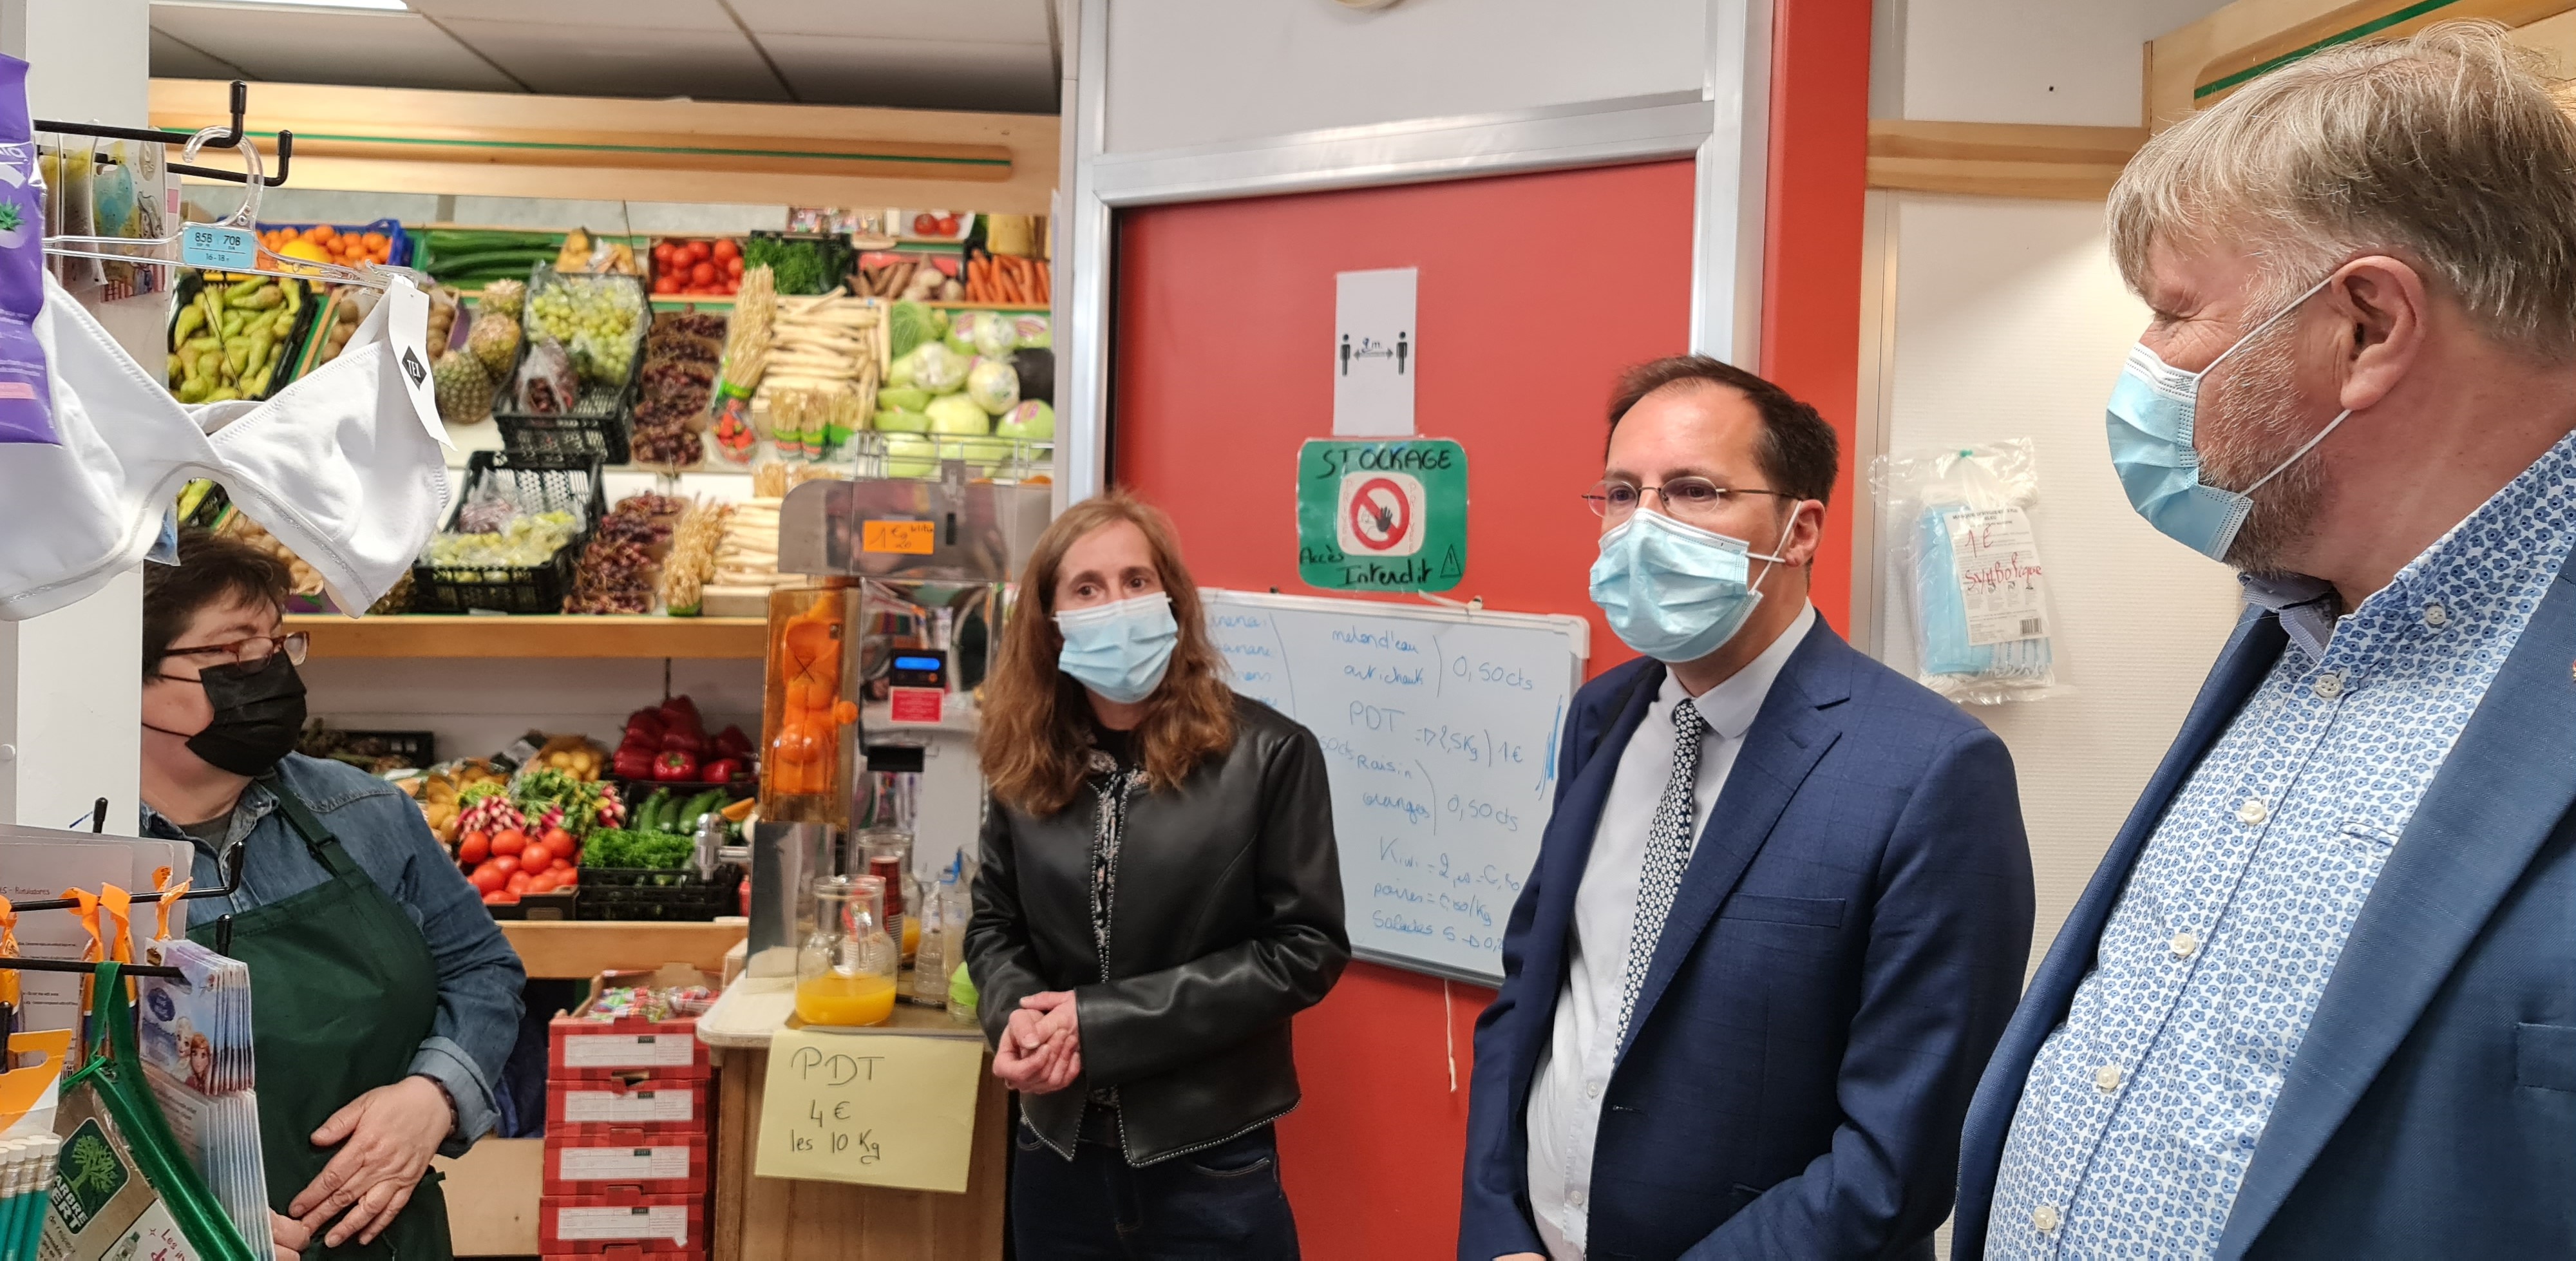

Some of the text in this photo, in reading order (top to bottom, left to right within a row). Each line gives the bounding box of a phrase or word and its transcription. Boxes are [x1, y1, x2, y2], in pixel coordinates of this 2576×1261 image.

[195, 232, 241, 245] 85B 70B
[406, 359, 421, 378] TEX
[1317, 449, 1452, 478] STOCKAGE
[1300, 545, 1344, 564] Accès
[1965, 529, 1977, 558] 1
[1337, 558, 1432, 587] Interdit
[1350, 701, 1405, 732] PDT
[791, 1046, 886, 1086] PDT
[810, 1099, 851, 1128] 4 €
[791, 1129, 813, 1152] les
[830, 1131, 849, 1153] 10
[56, 1175, 89, 1225] ARBRE
[161, 1228, 178, 1250] Les
